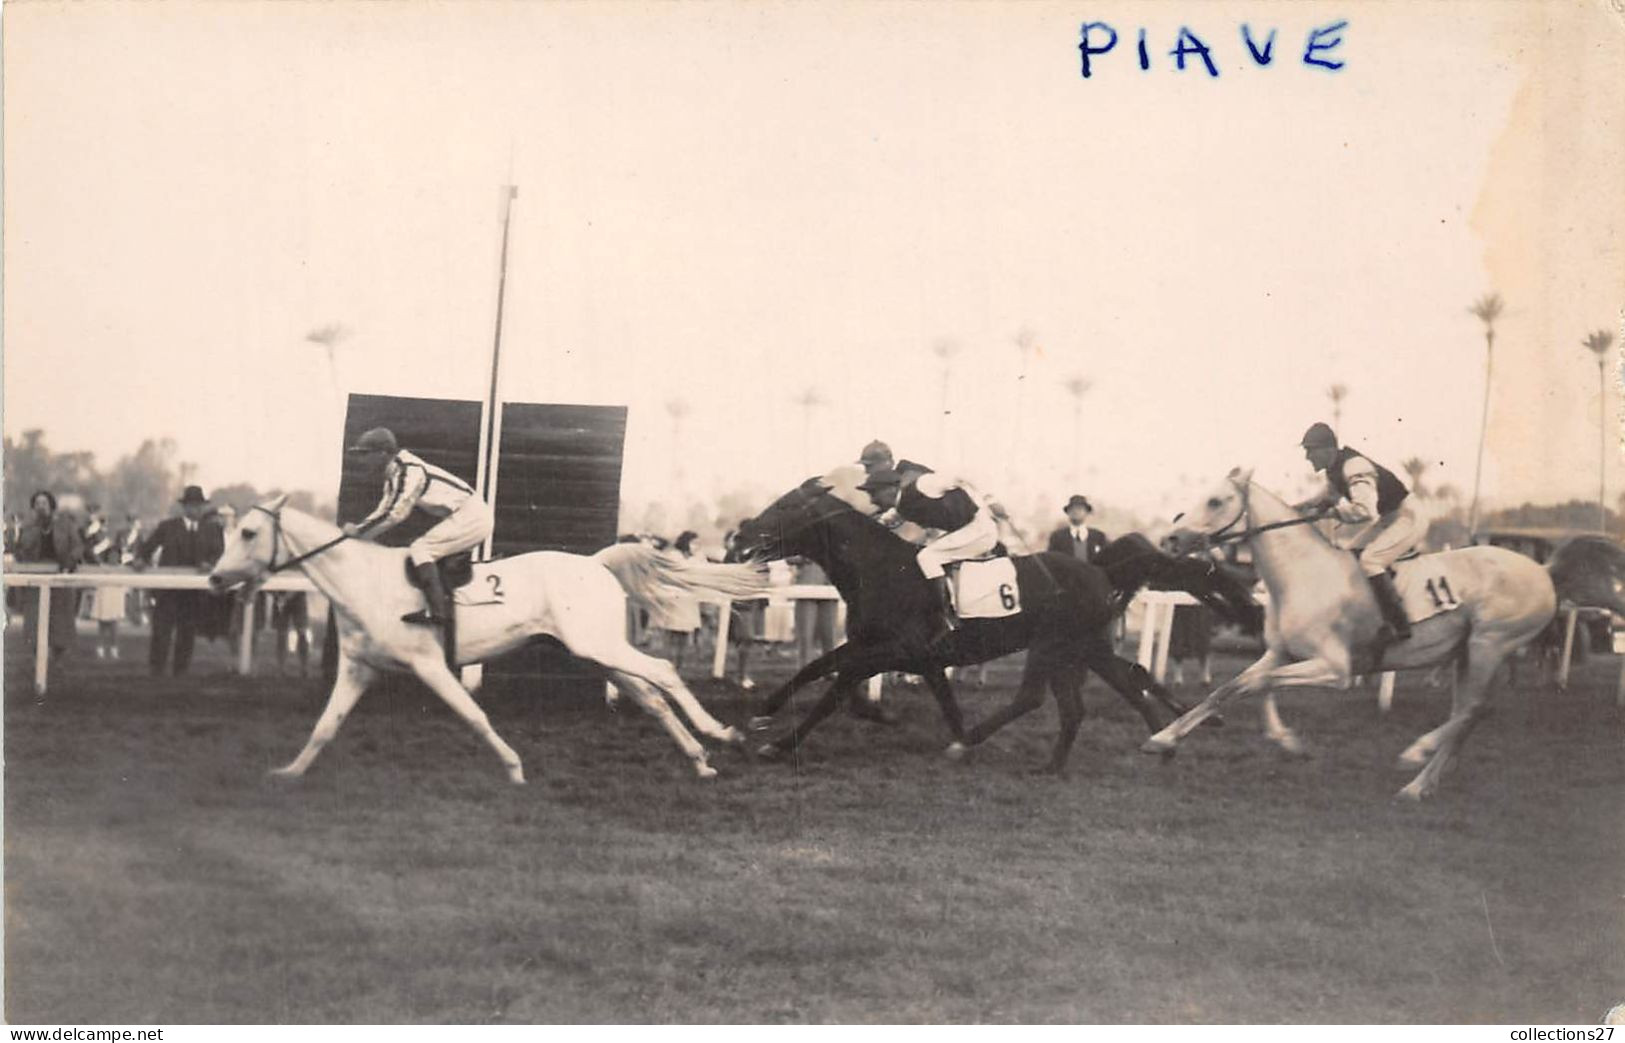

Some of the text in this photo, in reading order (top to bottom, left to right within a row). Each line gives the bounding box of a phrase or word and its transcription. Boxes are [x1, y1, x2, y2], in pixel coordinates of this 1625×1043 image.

[1078, 21, 1348, 78] PIAVE
[486, 575, 505, 597] 2
[998, 583, 1016, 610] 6
[1426, 576, 1457, 607] 11
